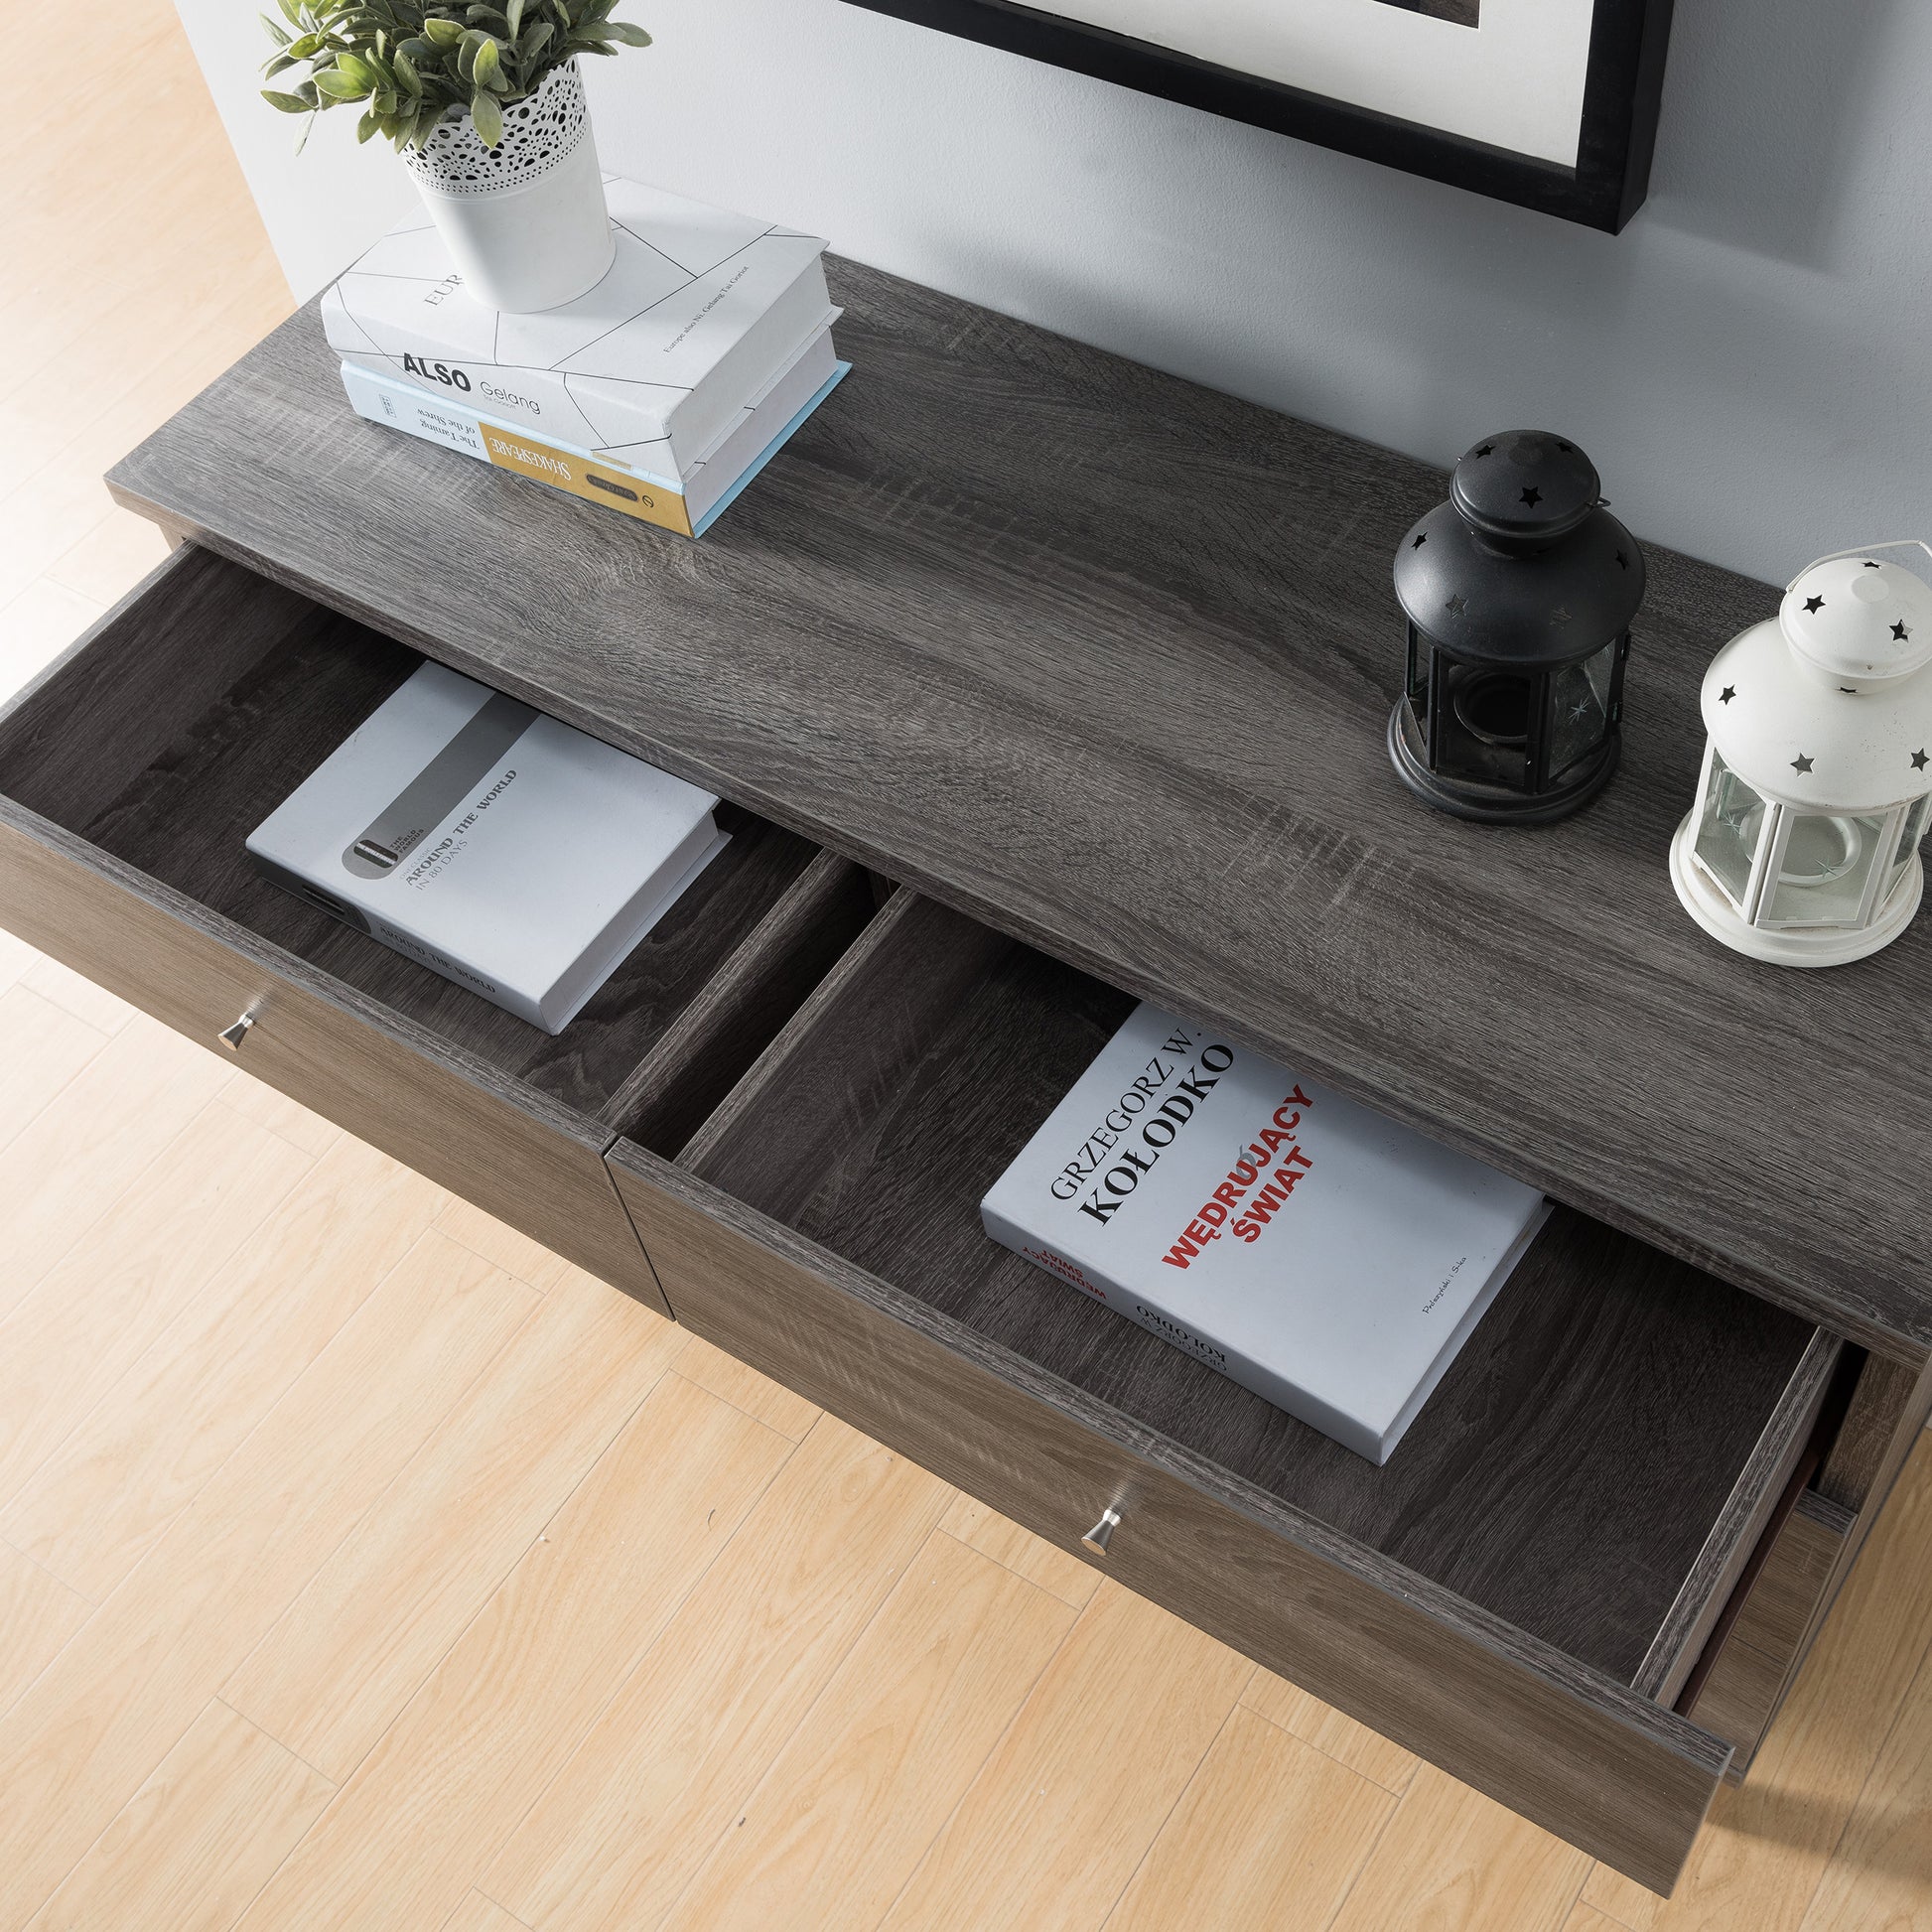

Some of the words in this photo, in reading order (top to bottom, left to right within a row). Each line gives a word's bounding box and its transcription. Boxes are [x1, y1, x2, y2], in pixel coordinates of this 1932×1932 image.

[683, 321, 697, 335] also
[403, 351, 472, 392] ALSO
[480, 381, 541, 415] Gelang
[416, 408, 447, 427] Shrew
[418, 418, 459, 443] Taming
[447, 418, 464, 432] the
[465, 425, 476, 435] of
[459, 435, 481, 450] The
[488, 437, 572, 482] SHAKESPEARE
[389, 836, 403, 849] THE
[393, 829, 417, 852] WORLD
[398, 828, 425, 854] FAMOUS
[405, 837, 454, 887] AROUND
[452, 812, 479, 835] THE
[476, 769, 517, 810] WORLD
[415, 878, 430, 891] IN
[428, 866, 443, 879] 80
[440, 839, 468, 866] DAYS
[429, 952, 452, 970] THE
[454, 966, 495, 993] WORLD
[1050, 1056, 1174, 1200] GRZEGORZ
[1161, 1028, 1202, 1055] W.
[1077, 1044, 1234, 1227] KOŁODKO
[1161, 1083, 1313, 1270] WĘDRUJĄCY
[1229, 1145, 1313, 1243] ŚWIAT
